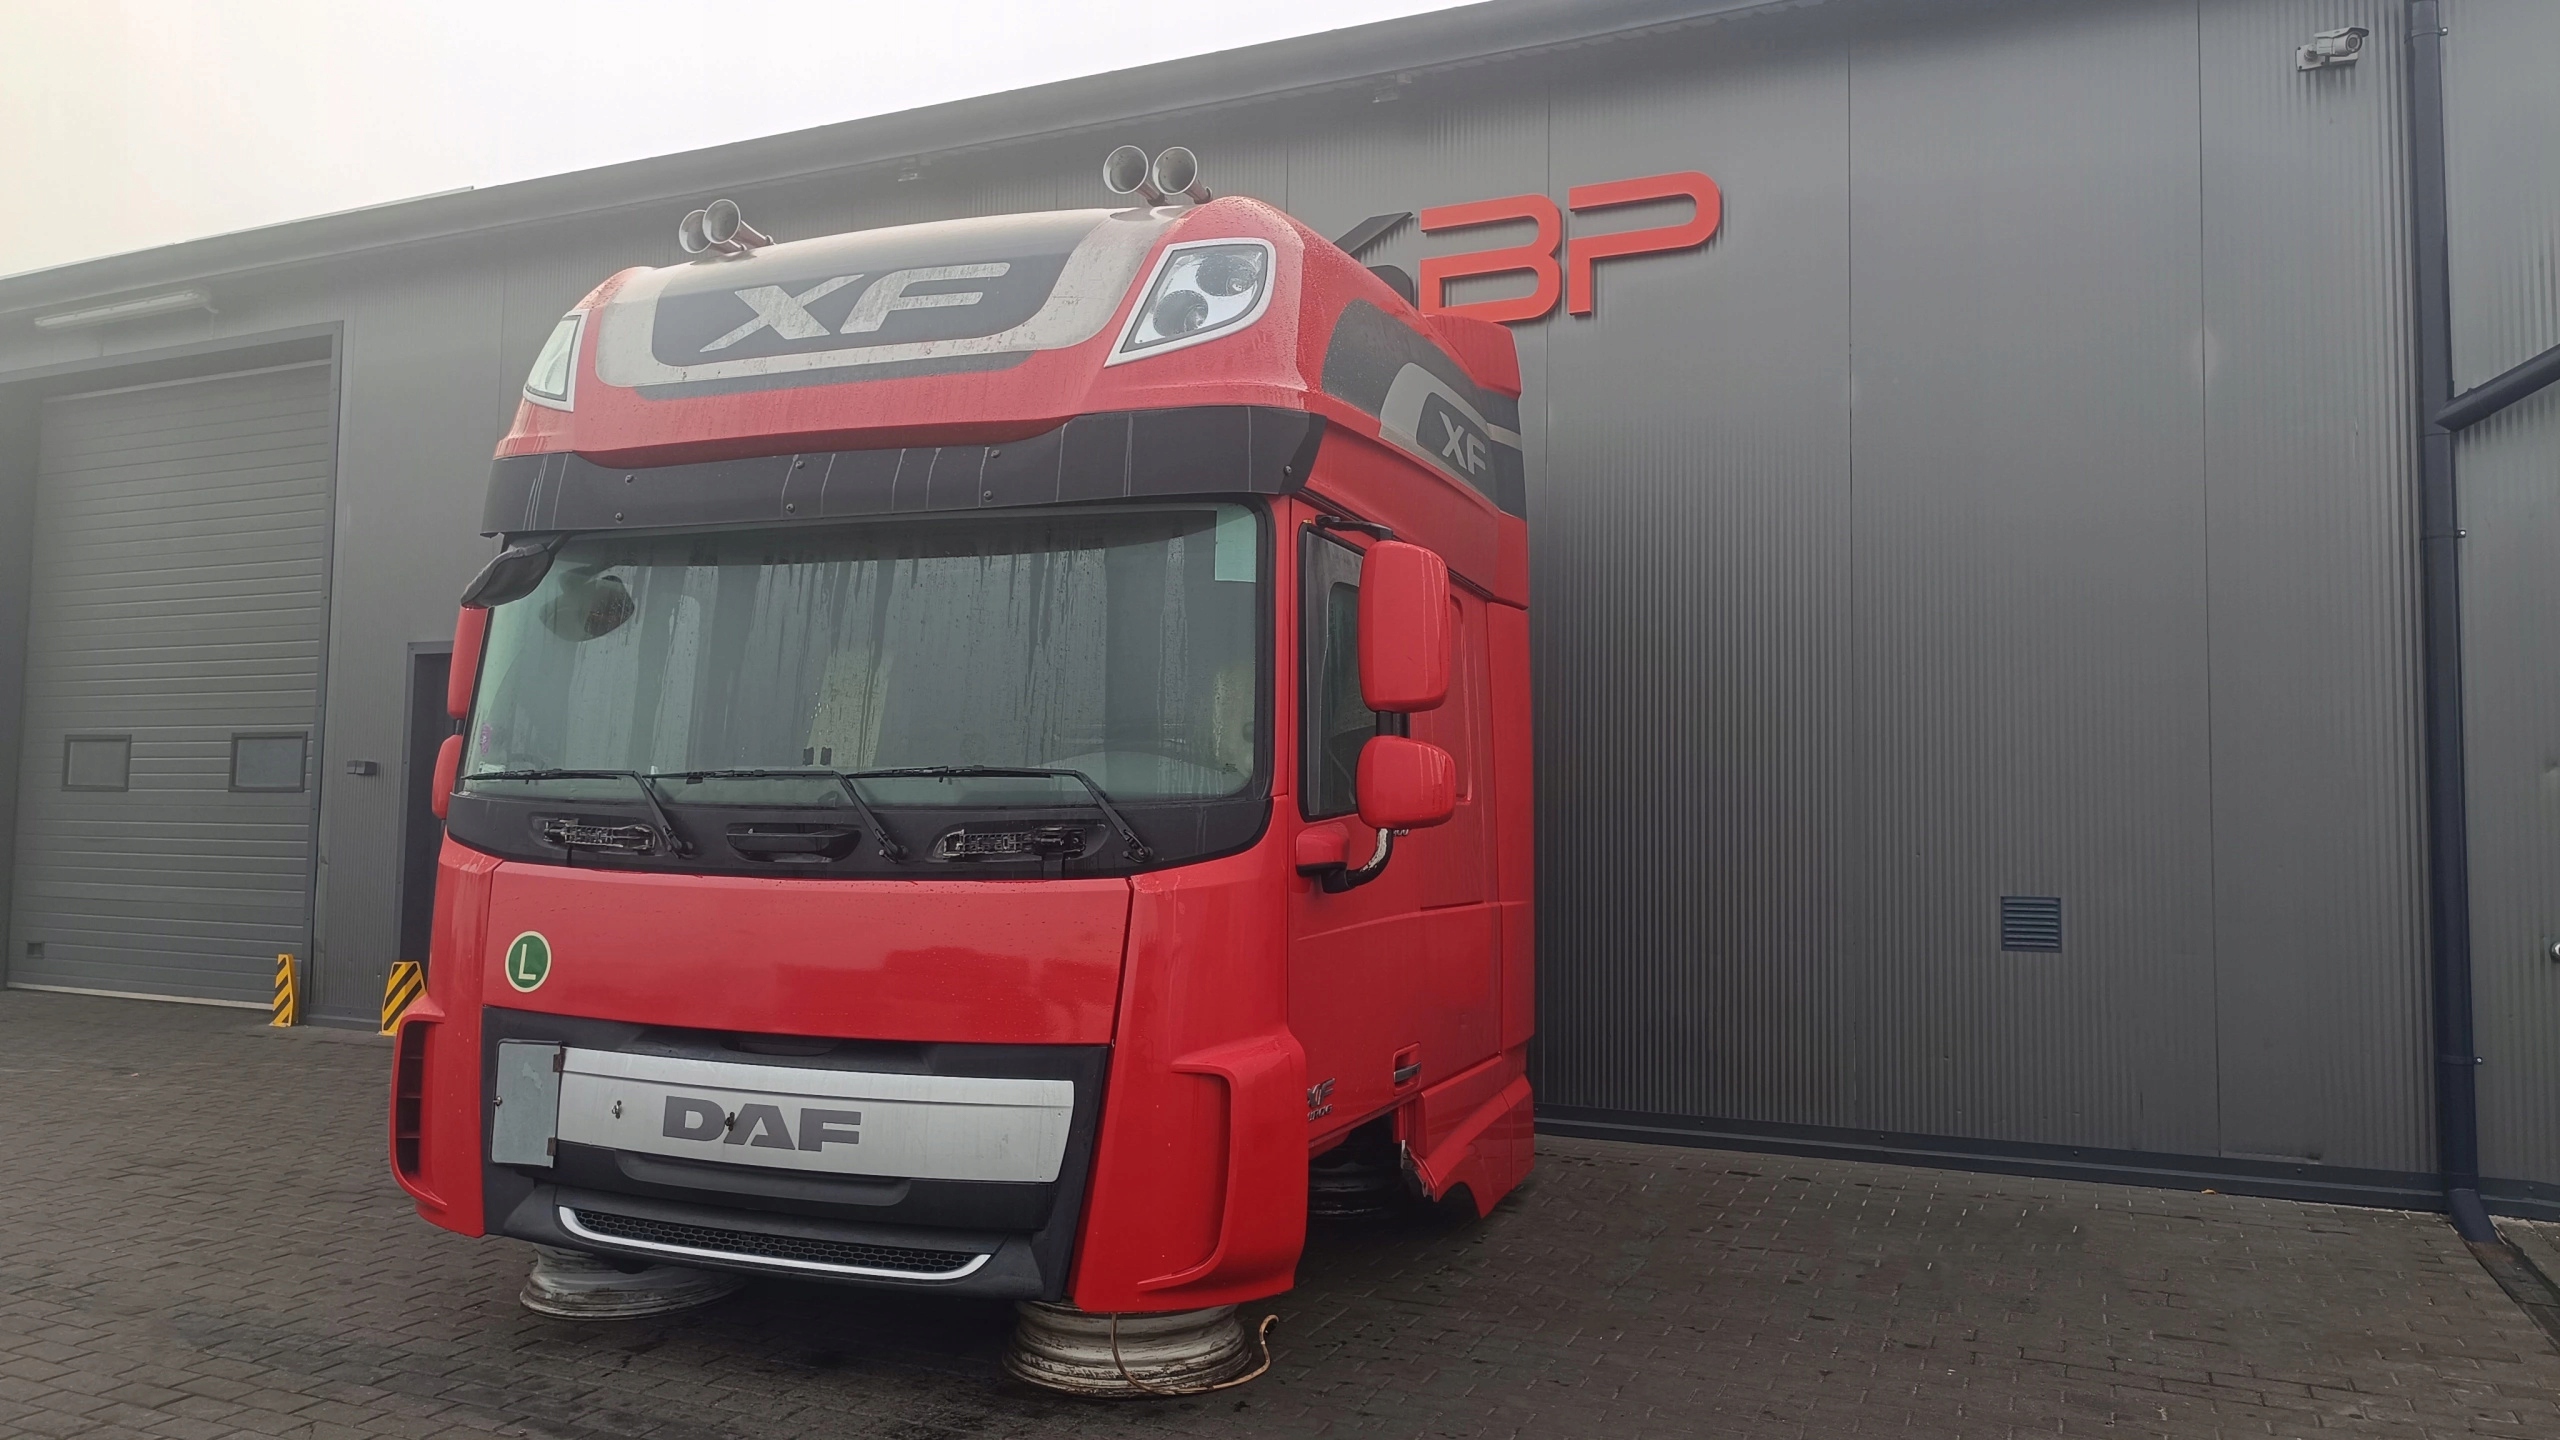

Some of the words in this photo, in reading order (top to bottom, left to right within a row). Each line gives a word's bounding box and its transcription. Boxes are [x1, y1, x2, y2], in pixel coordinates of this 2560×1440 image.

[1333, 170, 1721, 323] BP
[699, 261, 1011, 353] XF
[1438, 409, 1487, 476] XF
[517, 942, 538, 981] L
[662, 1095, 862, 1153] DAF
